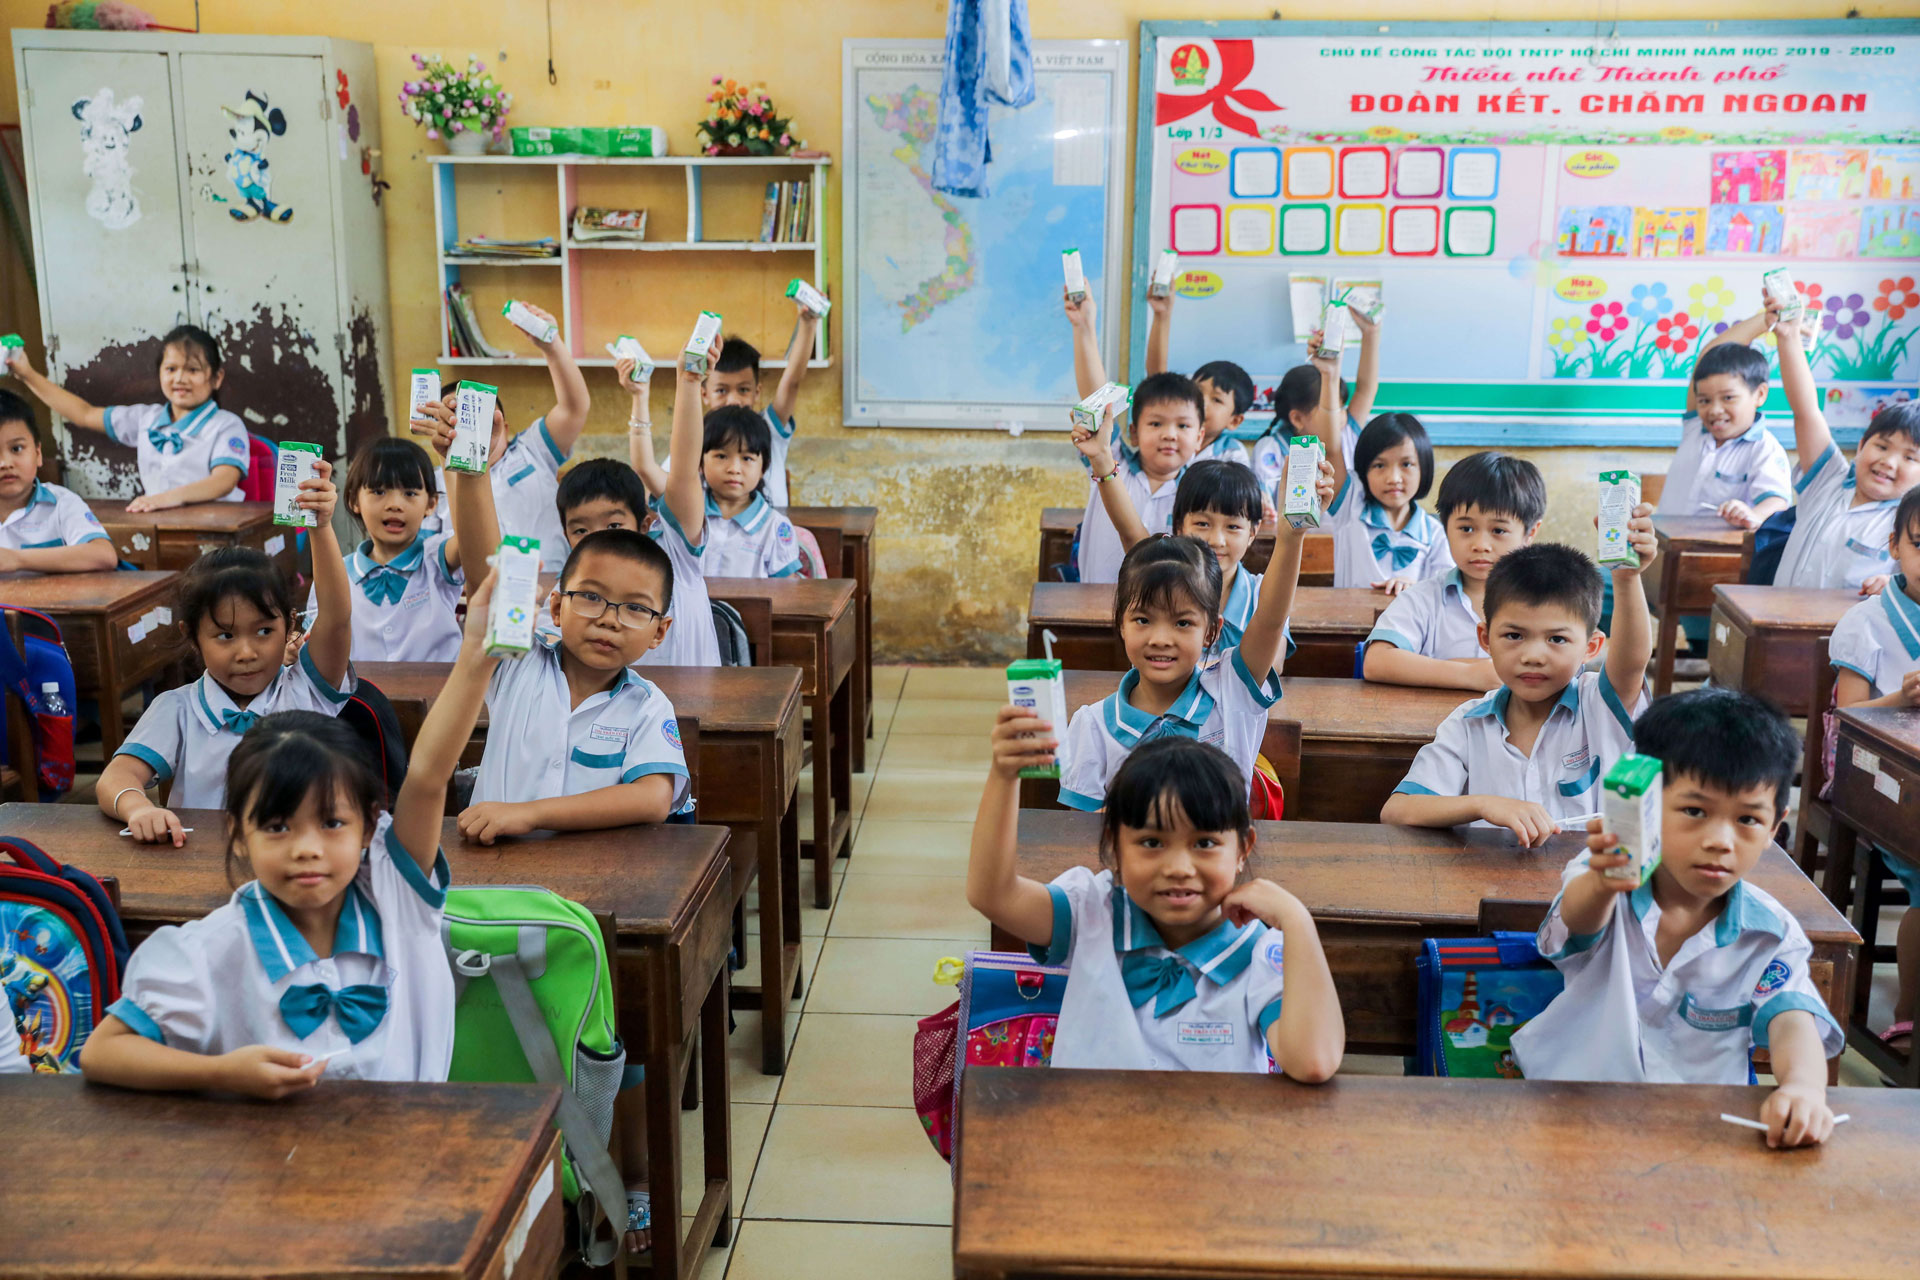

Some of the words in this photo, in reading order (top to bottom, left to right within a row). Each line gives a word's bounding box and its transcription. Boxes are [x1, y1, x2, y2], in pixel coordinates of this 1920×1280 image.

[1389, 46, 1438, 57] CÔNG
[1445, 46, 1477, 57] TÁC
[1519, 48, 1564, 57] TNTP
[1636, 47, 1687, 57] MINH
[1693, 46, 1736, 57] NĂM
[1742, 47, 1779, 58] HỌC
[1785, 46, 1831, 56] 2019
[1849, 45, 1896, 56] 2020
[1076, 55, 1104, 65] NAM
[1421, 64, 1518, 83] Thiếu
[1525, 66, 1584, 83] nhi
[1596, 65, 1704, 83] Thành
[1713, 63, 1788, 84] phố
[1349, 90, 1459, 113] ĐOÀN
[1580, 91, 1705, 113] CHĂM
[1723, 93, 1867, 113] NGOAN
[1168, 126, 1193, 141] Lớp
[1199, 126, 1223, 140] 1/3
